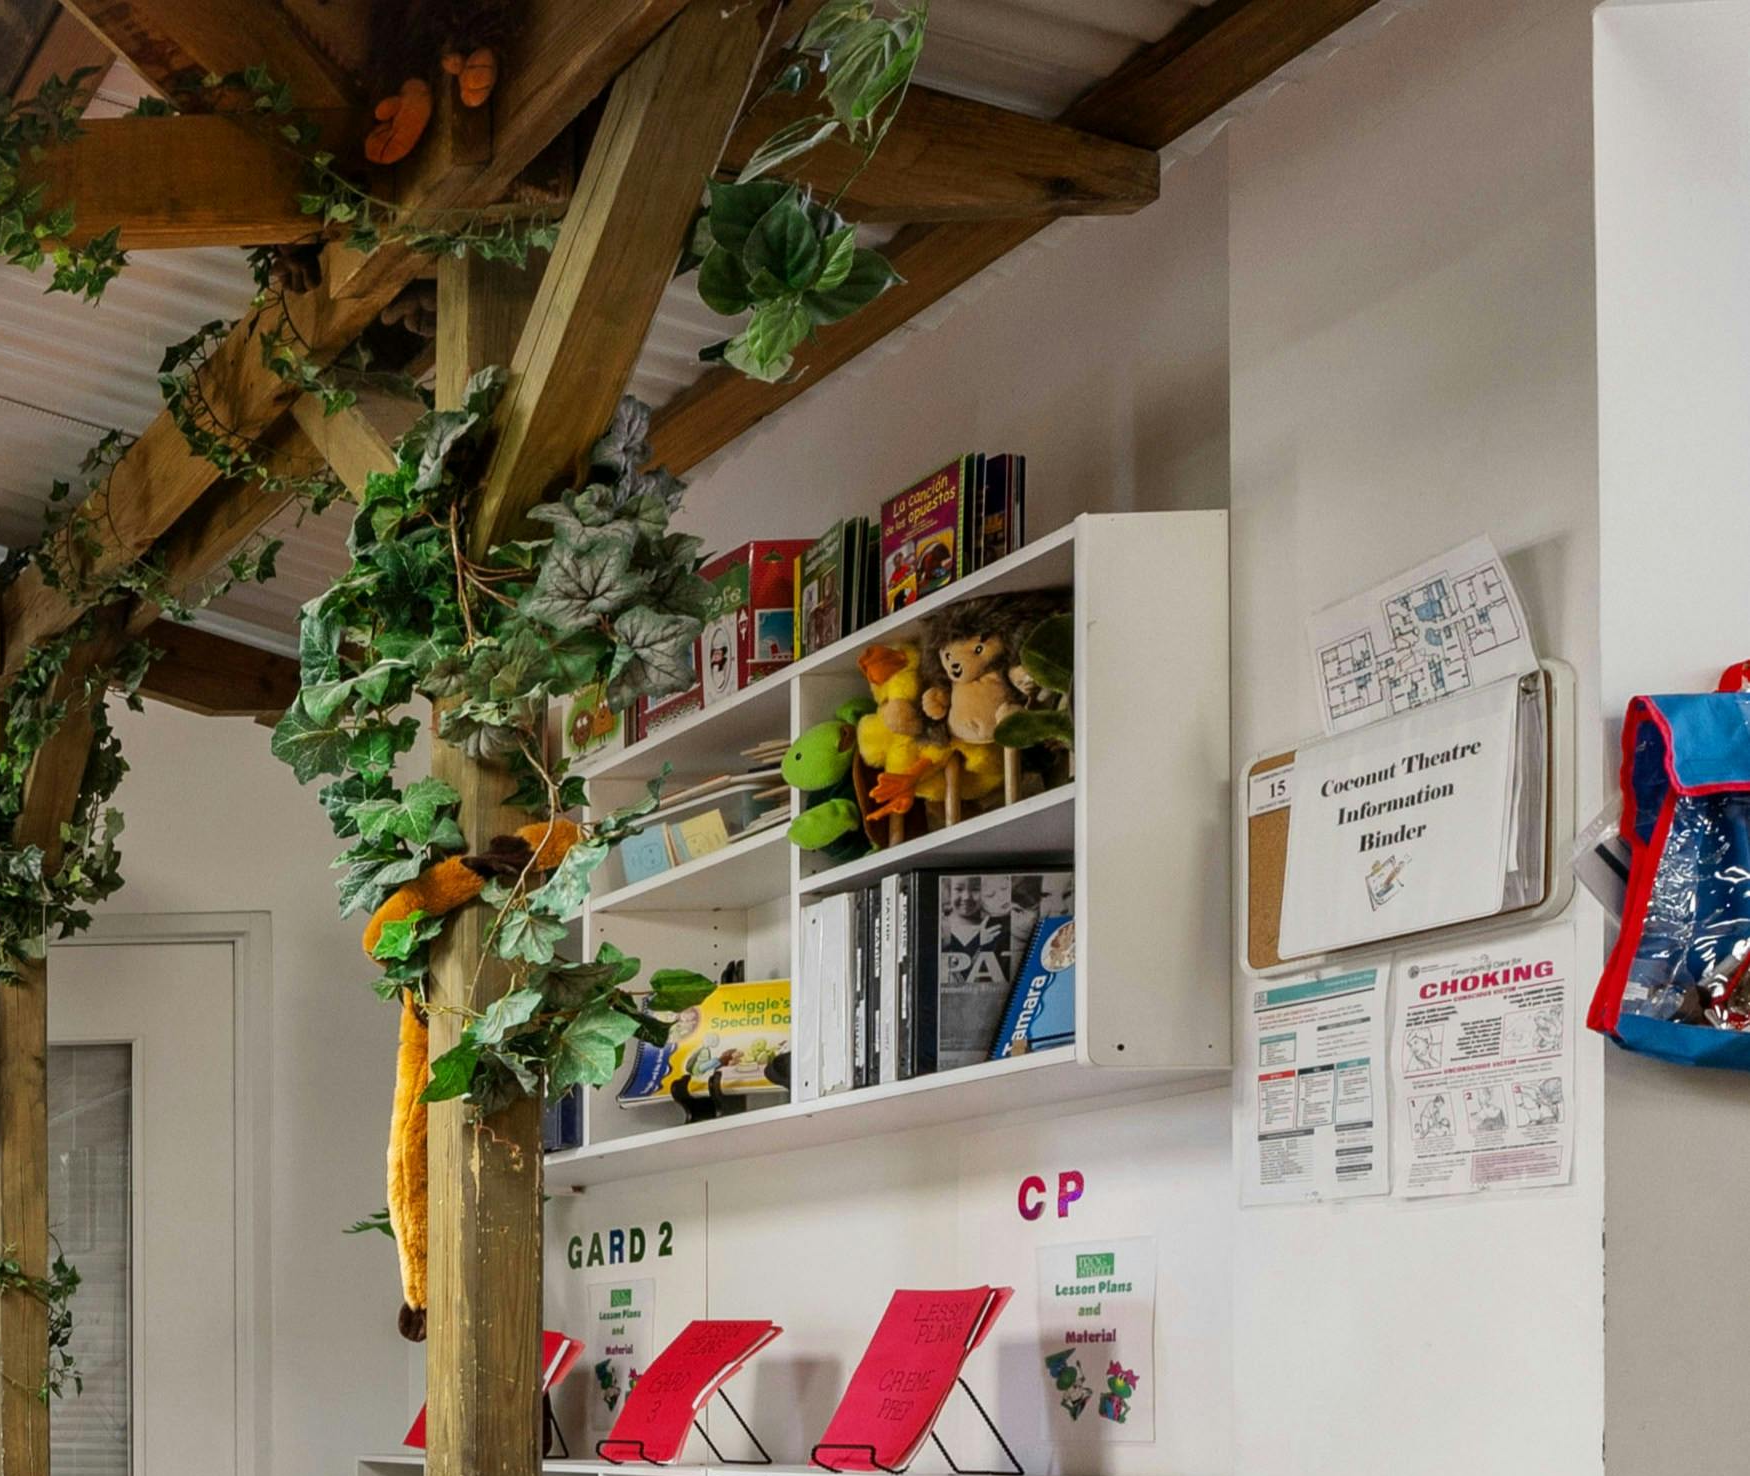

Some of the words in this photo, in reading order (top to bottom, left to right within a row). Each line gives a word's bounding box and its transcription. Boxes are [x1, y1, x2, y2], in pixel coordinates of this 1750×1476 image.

[892, 500, 906, 519] La
[908, 474, 948, 507] canción
[908, 485, 957, 526] opuestos
[1320, 763, 1396, 798] Coconut
[1401, 739, 1482, 775] Theatre
[1269, 779, 1287, 799] 15
[1337, 782, 1455, 826] Information
[1358, 823, 1427, 852] Binder
[1419, 960, 1554, 1000] CHOKING
[722, 997, 791, 1014] Twiggle's
[1001, 975, 1047, 1056] Tamara
[711, 1014, 765, 1030] Special
[770, 1013, 792, 1025] Da
[1465, 1092, 1473, 1101] 2
[568, 1227, 646, 1270] GARD
[658, 1220, 673, 1257] 2
[1055, 1283, 1096, 1296] Lesson
[1098, 1280, 1132, 1294] Plans
[1078, 1302, 1101, 1317] and
[611, 1324, 625, 1336] and
[1065, 1328, 1117, 1344] Material
[605, 1343, 634, 1356] Material
